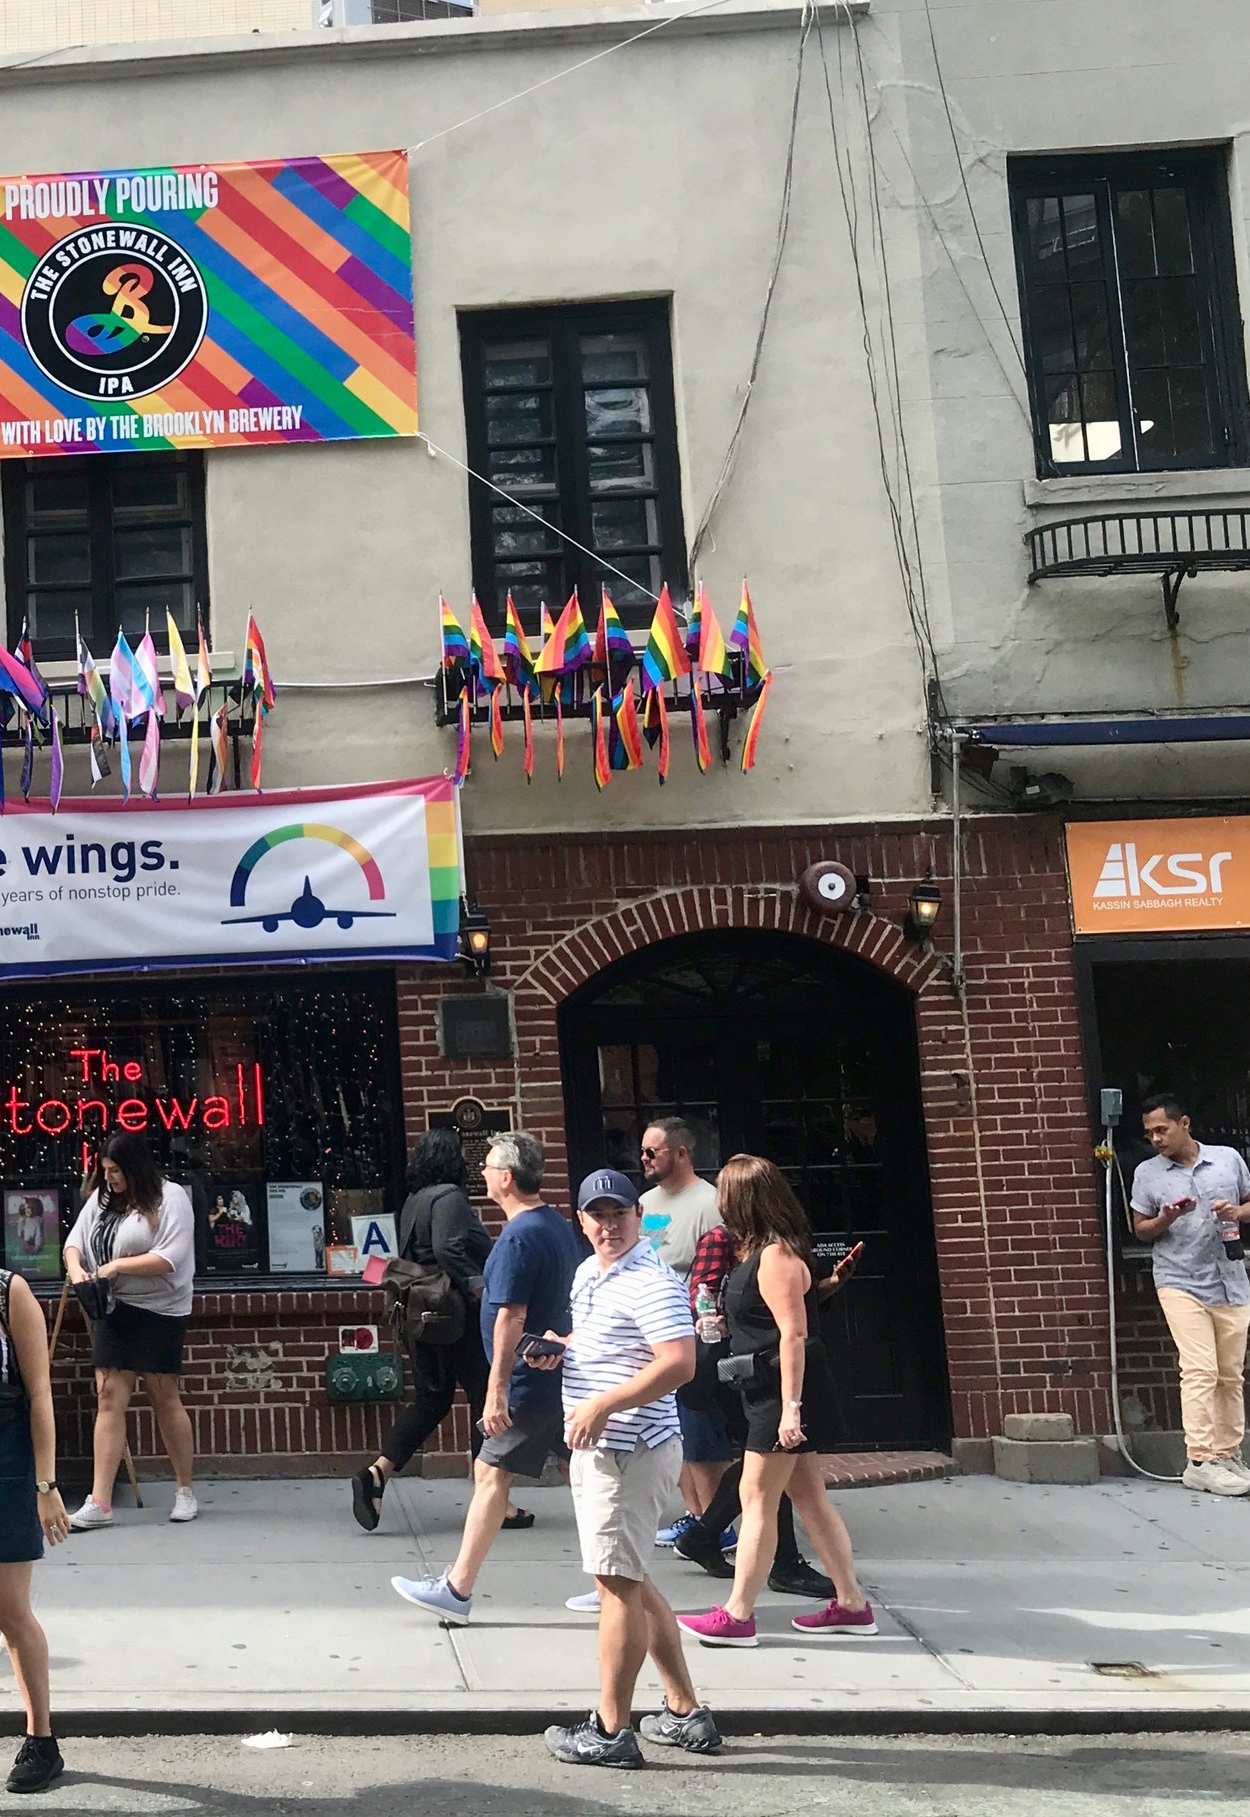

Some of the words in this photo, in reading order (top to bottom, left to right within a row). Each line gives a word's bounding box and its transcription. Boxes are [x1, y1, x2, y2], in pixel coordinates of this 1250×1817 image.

[5, 178, 109, 221] PROUDLY
[116, 172, 219, 213] POURING
[30, 263, 60, 302] THE
[56, 229, 167, 268] STONEWALL
[166, 255, 201, 293] INN
[98, 376, 134, 395] IPA
[0, 418, 41, 445] WITH
[44, 416, 83, 442] LOVE
[85, 415, 106, 440] BY
[110, 412, 140, 439] THE
[142, 408, 226, 437] BROOKLYN
[228, 405, 303, 431] BREWERY
[22, 833, 180, 883] wings.
[1125, 843, 1232, 896] ksr
[1, 889, 46, 908] years
[49, 886, 63, 902] of
[68, 884, 130, 904] nonstop
[135, 881, 181, 903] pride.
[1093, 901, 1131, 911] KASSIN
[1133, 899, 1182, 909] SABBAGH
[1184, 897, 1224, 908] REALTY
[70, 1049, 142, 1083] The
[362, 1221, 391, 1255] A
